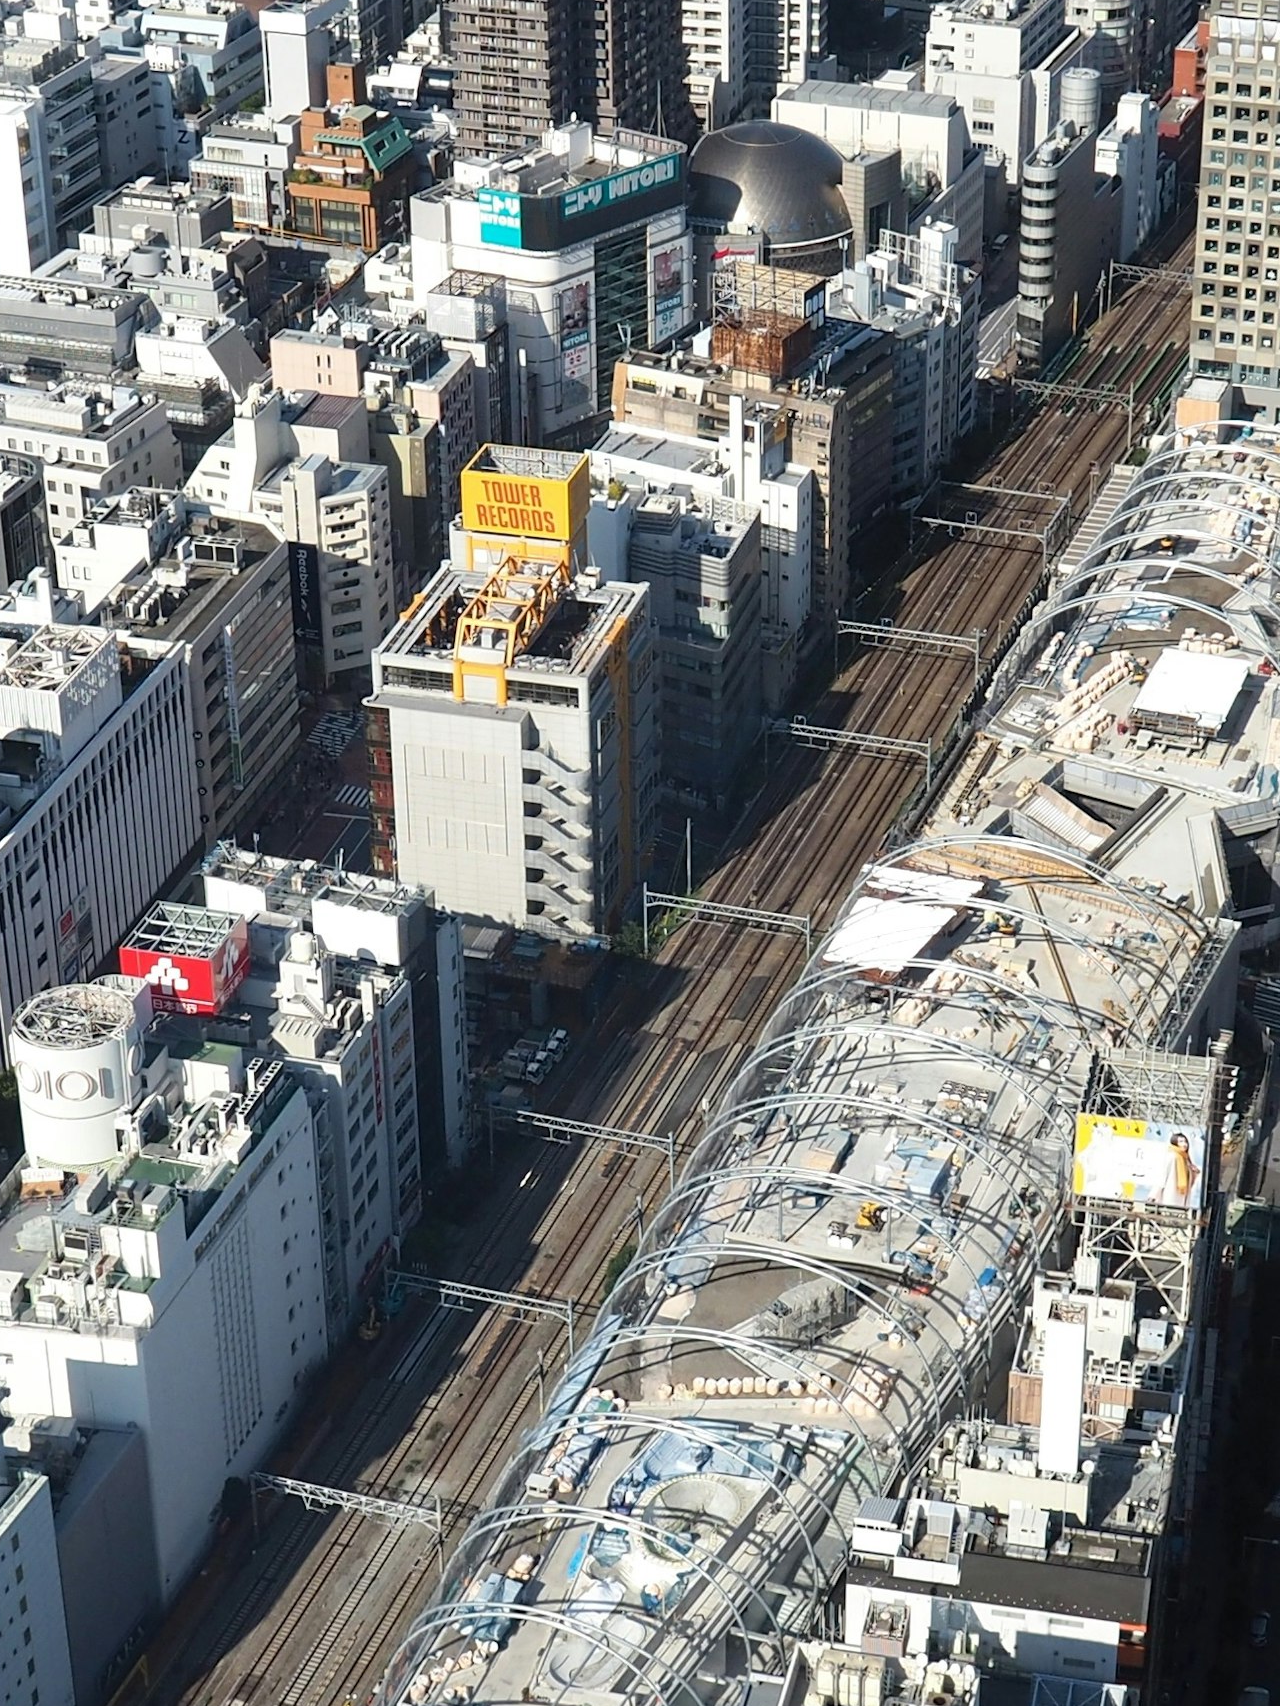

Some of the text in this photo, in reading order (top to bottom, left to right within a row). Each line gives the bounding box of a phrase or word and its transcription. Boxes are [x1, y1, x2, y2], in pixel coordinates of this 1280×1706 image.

[564, 158, 675, 216] ニトリ NITORI
[479, 192, 521, 214] ニトリ
[479, 212, 521, 227] NITORI
[481, 480, 542, 507] TOWER
[475, 504, 556, 533] RECORDS
[296, 549, 309, 596] Reebok
